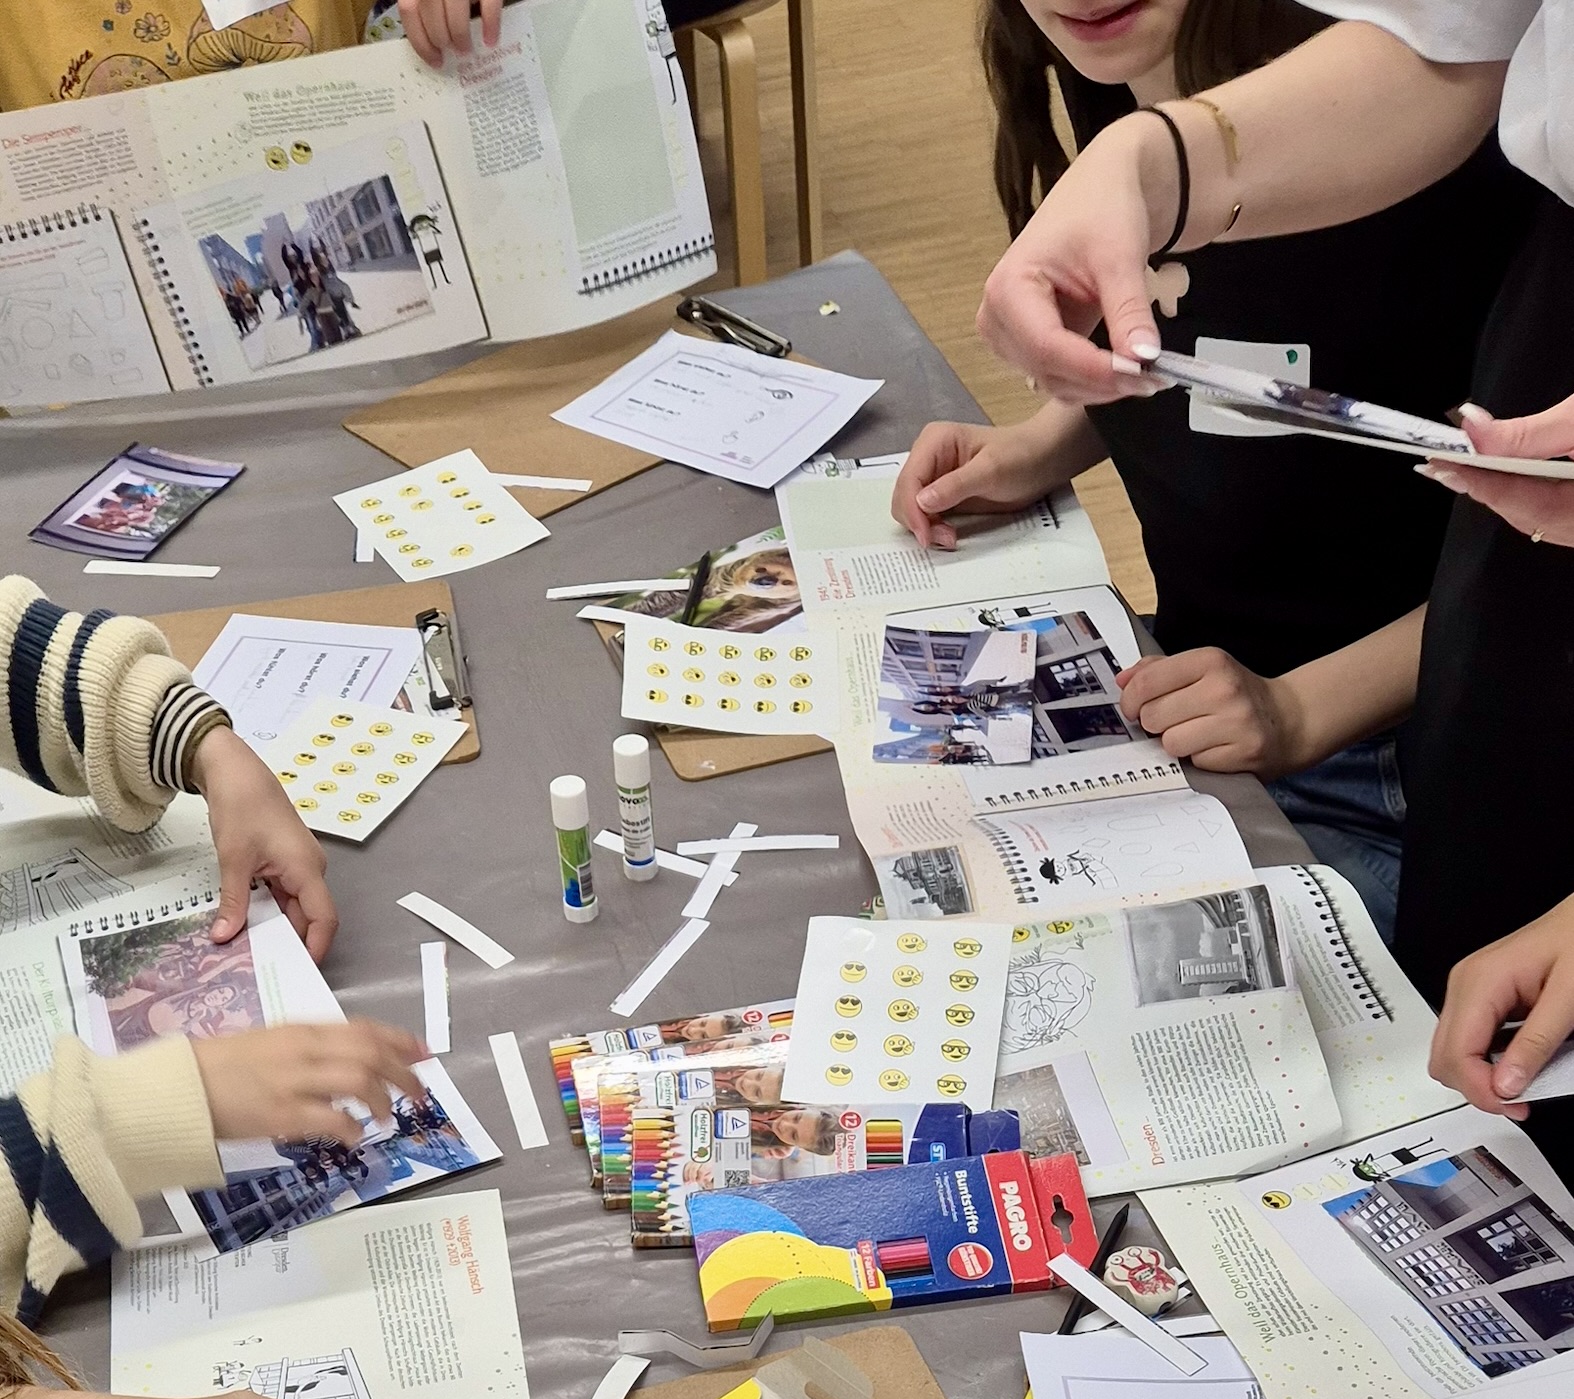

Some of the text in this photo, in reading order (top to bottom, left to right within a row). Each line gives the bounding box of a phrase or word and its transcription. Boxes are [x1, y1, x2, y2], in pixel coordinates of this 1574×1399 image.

[698, 1112, 708, 1144] Holzfrei
[843, 1113, 858, 1127] 12
[954, 1169, 979, 1234] Buntstifte
[998, 1180, 1032, 1251] PAGRO
[456, 1214, 484, 1295] Wolfgang Hänsch
[860, 1242, 877, 1287] 12 Farben
[1434, 1238, 1483, 1290] SEMPER
[1243, 1300, 1260, 1320] das
[1251, 1318, 1273, 1343] Weil
